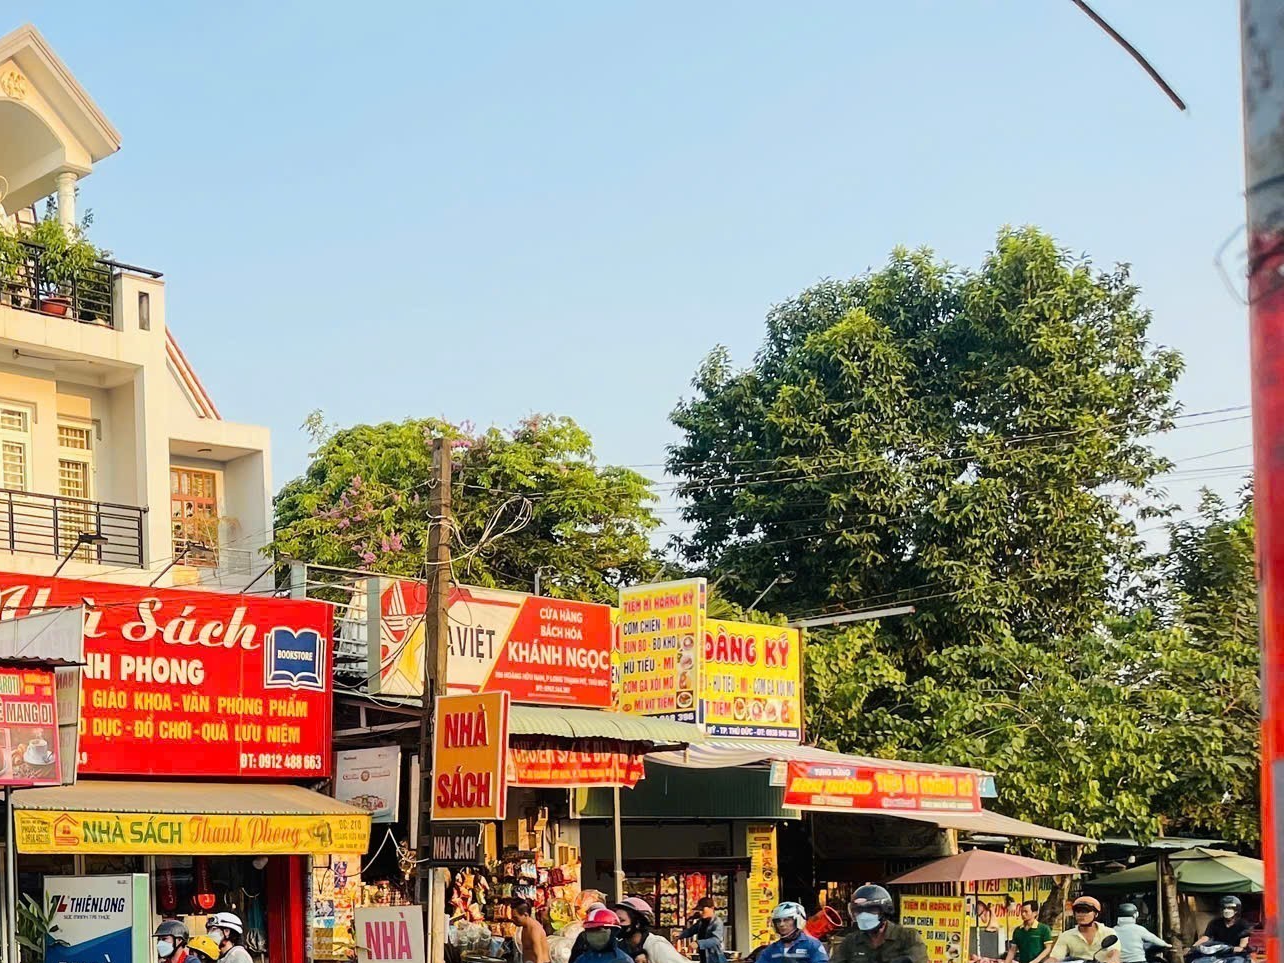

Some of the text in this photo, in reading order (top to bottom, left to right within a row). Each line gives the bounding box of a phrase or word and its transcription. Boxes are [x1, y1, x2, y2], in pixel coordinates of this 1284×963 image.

[122, 597, 261, 650] Sách
[539, 606, 584, 624] CỬA HÀNG
[540, 622, 583, 641] BÁCH HÓA
[277, 648, 314, 663] BOOKSTORE
[507, 637, 610, 674] KHÁNH NGỌC
[765, 633, 789, 669] KÝ
[121, 658, 205, 686] PHONG
[5, 701, 39, 724] MANG
[40, 703, 54, 724] ĐI
[93, 687, 308, 718] GIÁO KHOA VĂN PHÒNG PHẨM
[92, 714, 301, 748] DỤC ĐỒ CHƠI QUÀ LƯU NIỆM
[444, 703, 490, 749] NHÀ
[240, 752, 257, 769] ĐT:
[258, 753, 283, 769] 0912
[284, 753, 303, 770] 488
[304, 754, 322, 770] 663
[436, 764, 493, 810] SÁCH
[82, 814, 126, 844] NHÀ
[130, 814, 183, 845] SÁCH
[188, 814, 244, 845] Thanh
[246, 815, 302, 849] Phong
[433, 828, 476, 860] NHÀ SÁCH
[70, 894, 125, 913] THIÊNLONG
[365, 911, 413, 960] NHÀ
